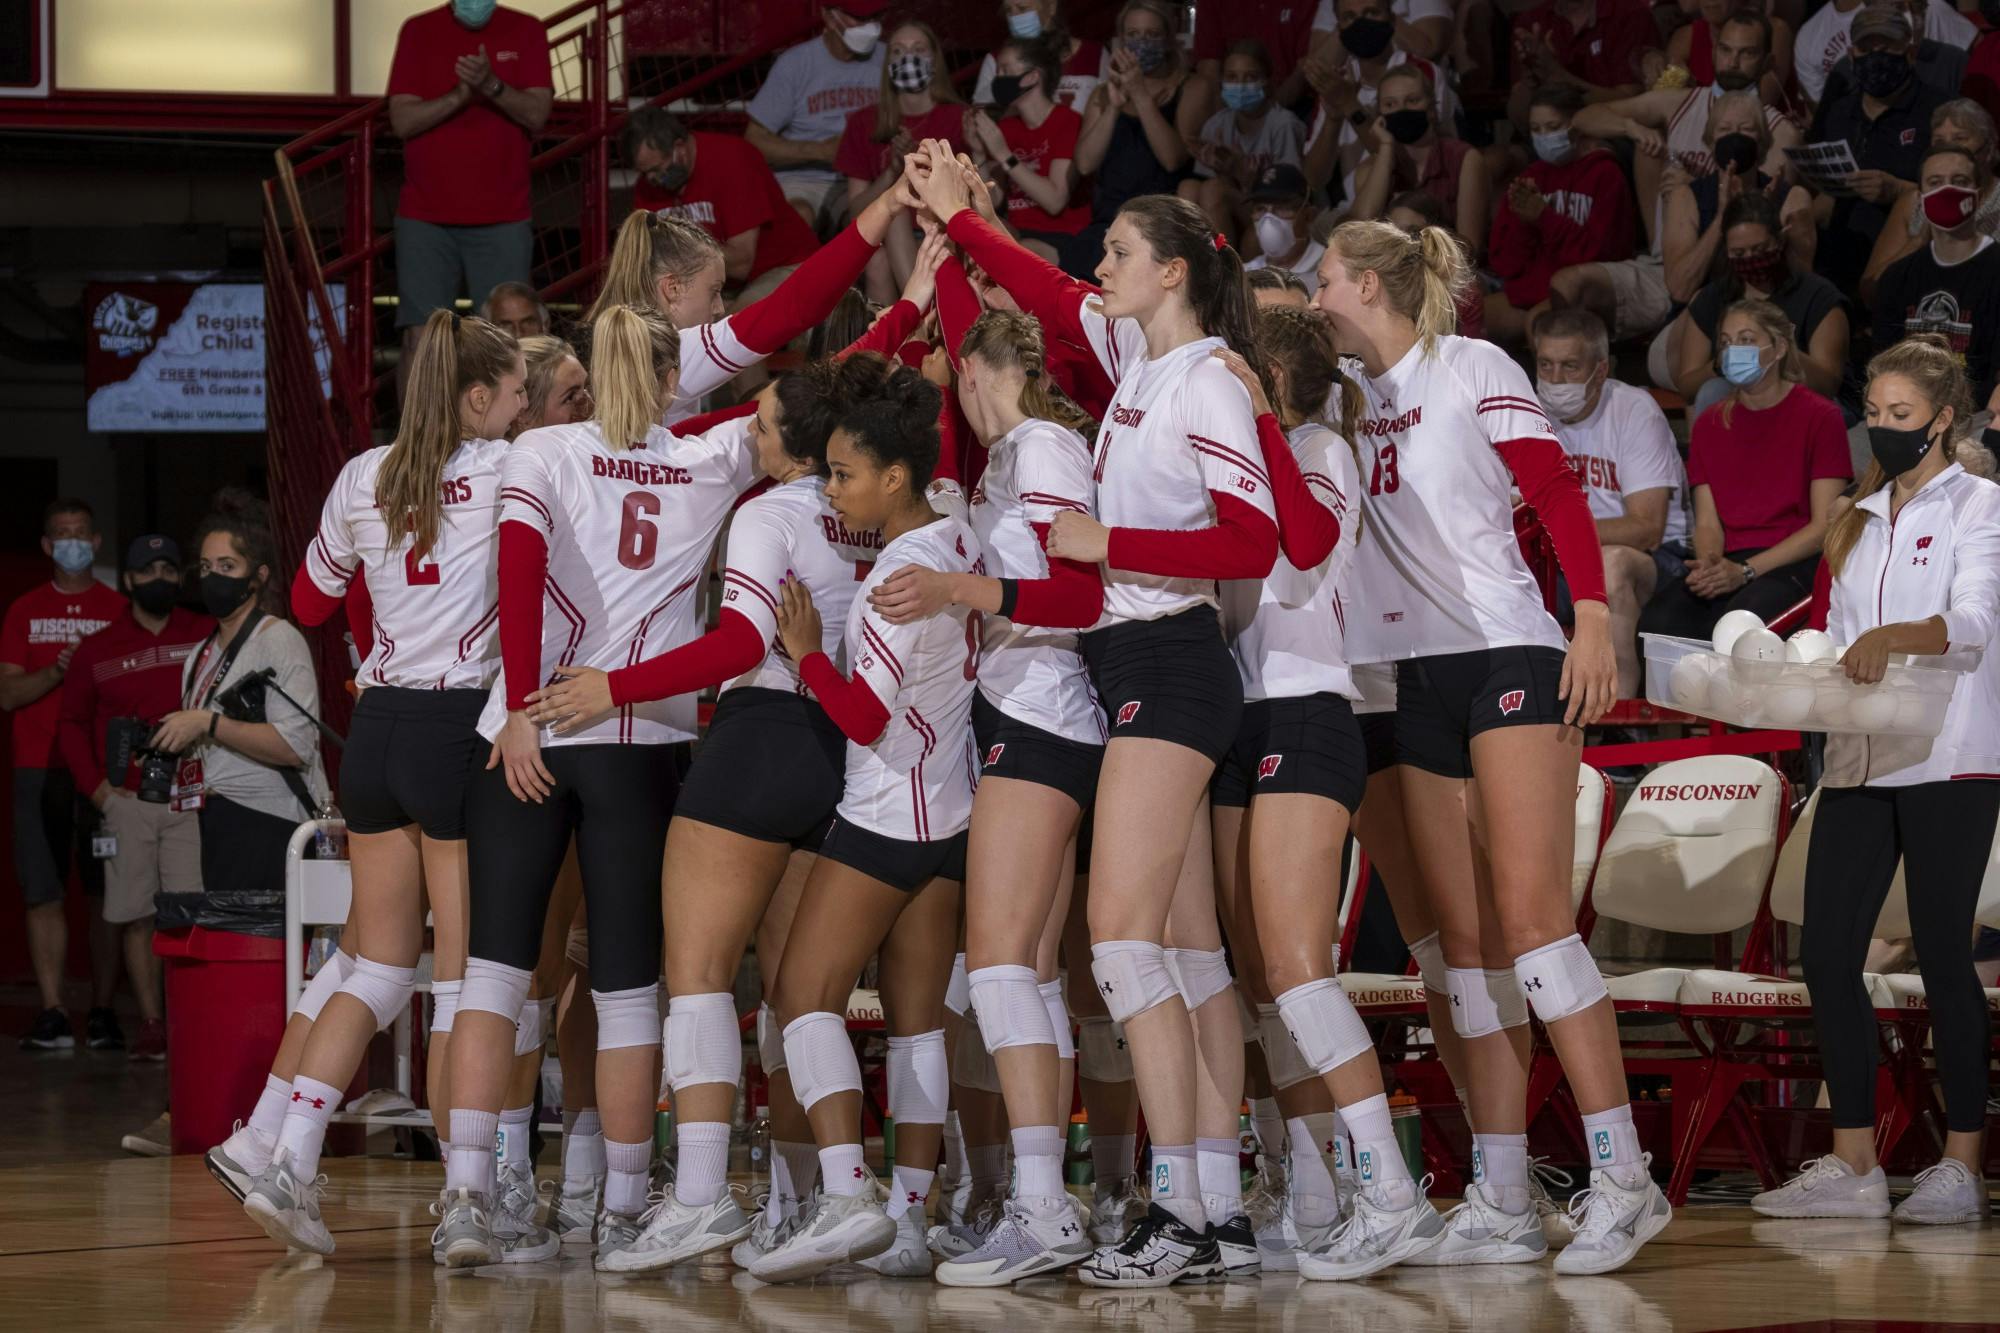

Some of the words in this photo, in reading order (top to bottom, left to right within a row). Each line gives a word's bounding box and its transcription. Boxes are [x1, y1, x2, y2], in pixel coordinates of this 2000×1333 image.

[201, 334, 252, 350] Child
[208, 384, 250, 396] Grade
[1369, 443, 1400, 497] 13
[617, 491, 661, 571] 6
[1639, 784, 1763, 802] WISCONSIN
[1347, 988, 1426, 1004] BADGERS
[1711, 991, 1802, 1007] BADGERS
